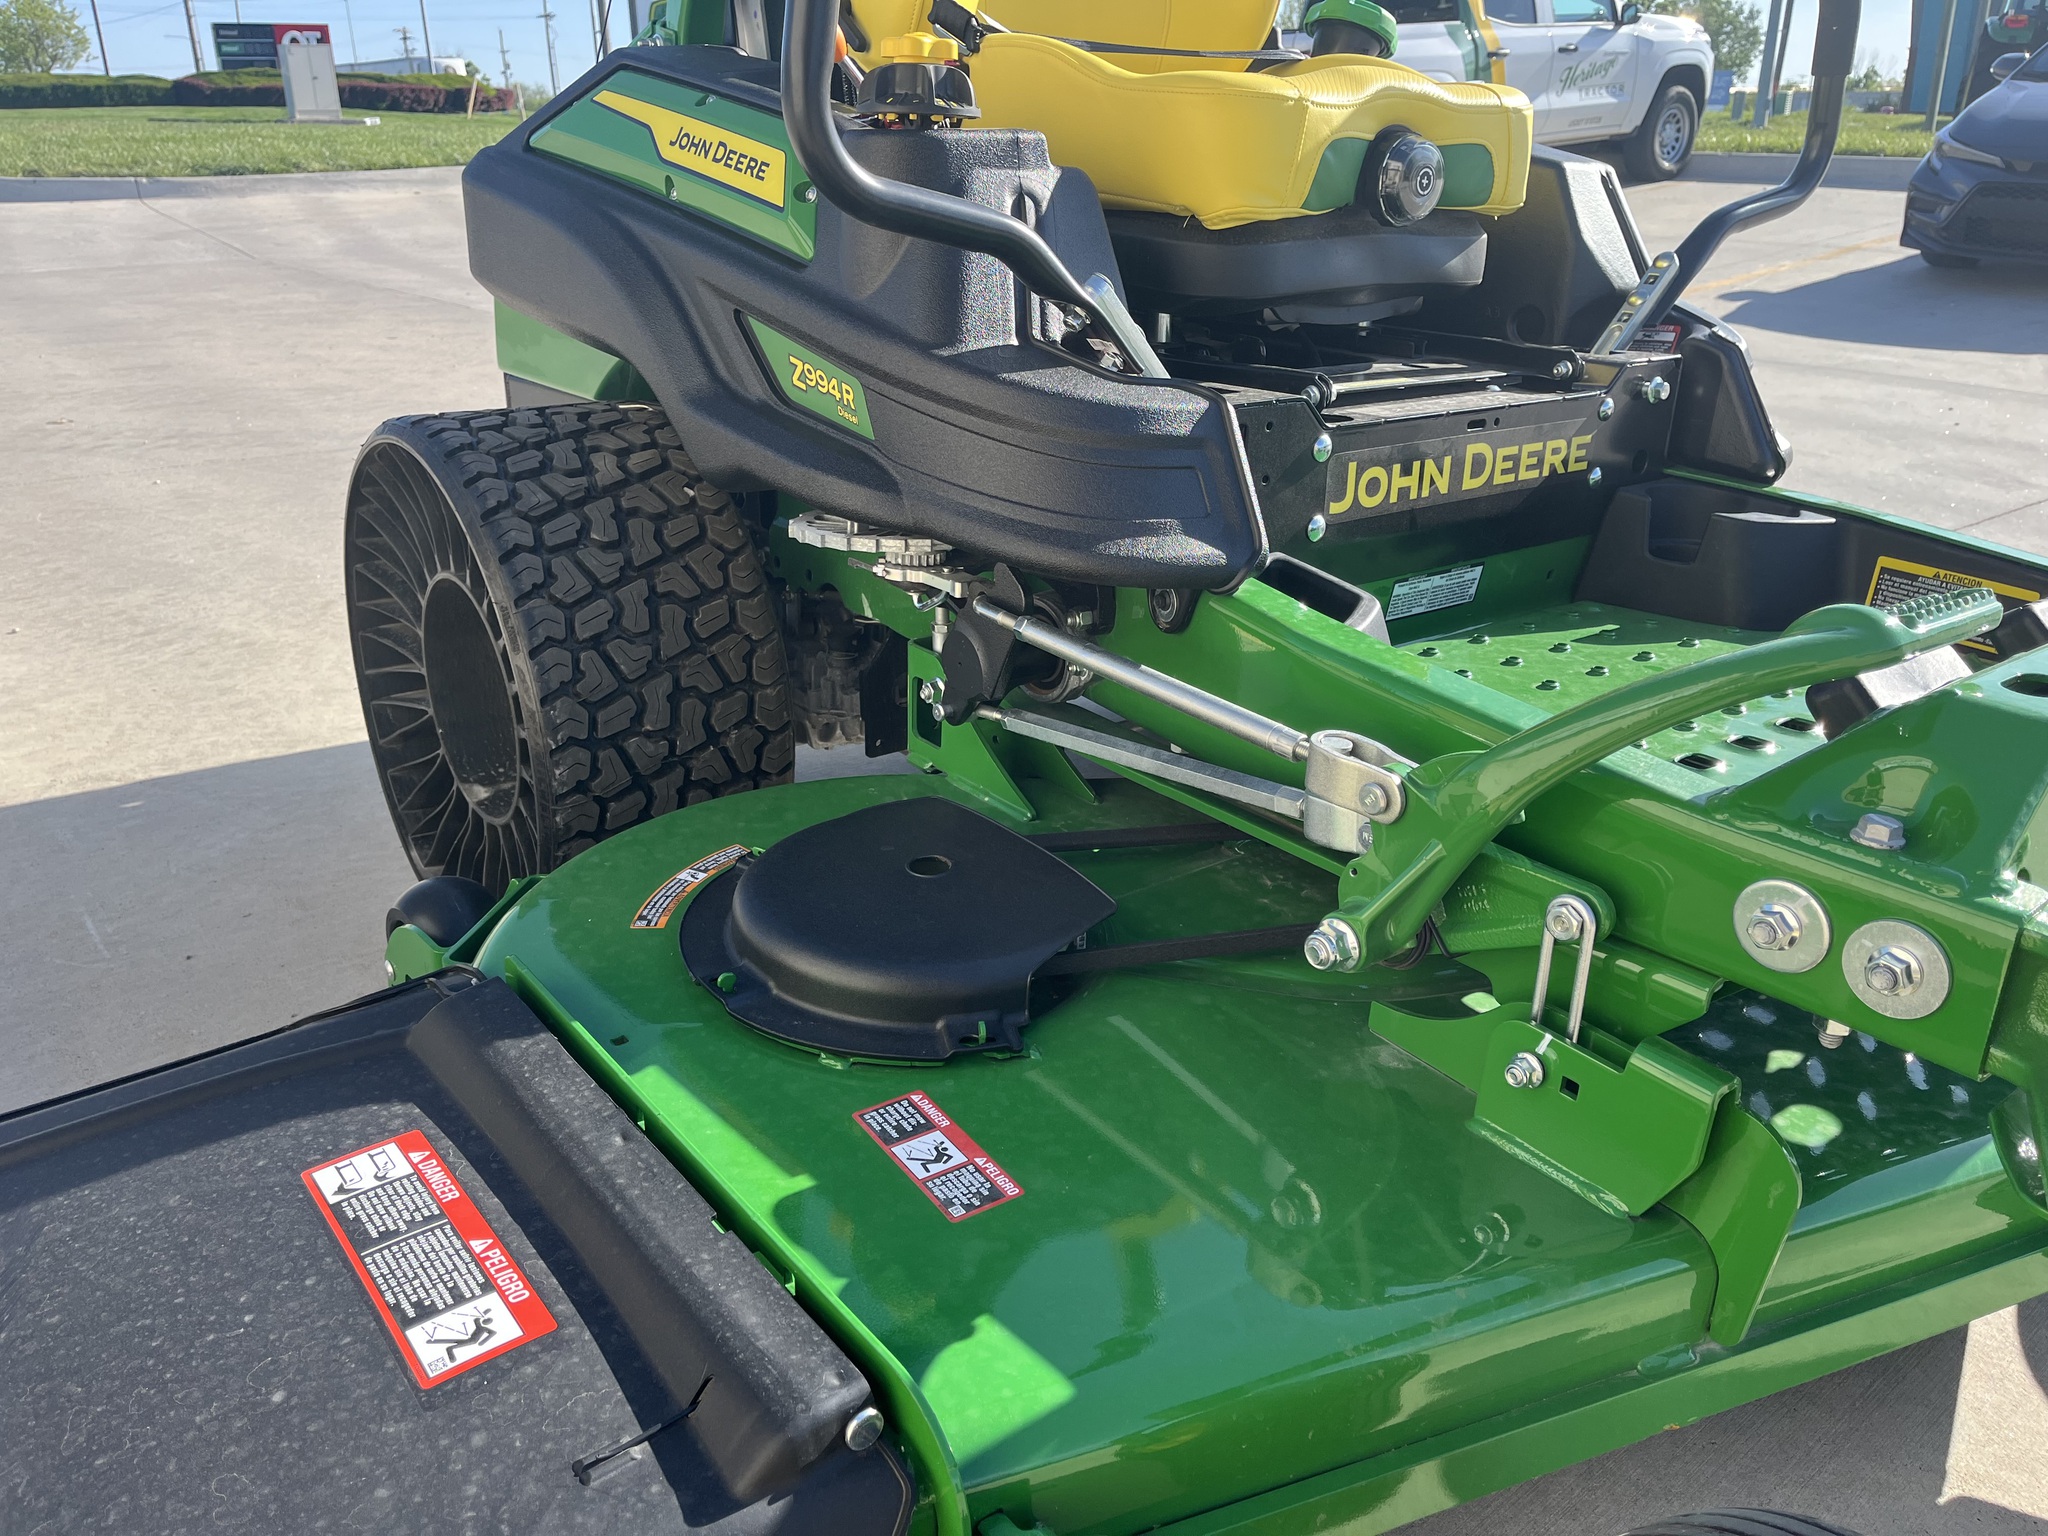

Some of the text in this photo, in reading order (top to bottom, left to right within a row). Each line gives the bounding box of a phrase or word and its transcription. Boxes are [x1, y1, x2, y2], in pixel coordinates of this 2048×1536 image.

[1556, 55, 1617, 98] Heritage
[1579, 84, 1625, 98] TRACTOR
[669, 126, 771, 182] JOHN DEERE
[788, 353, 857, 412] Z994R
[837, 405, 859, 426] Diesel
[1328, 434, 1593, 515] JOHN DEERE
[1918, 576, 1941, 587] AYUDAR
[1942, 573, 1983, 588] ATENCION
[881, 1112, 899, 1126] entire
[882, 1104, 915, 1132] charge chute
[891, 1101, 912, 1118] without
[899, 1099, 927, 1124] Do not mow
[915, 1098, 951, 1128] DANGER
[864, 1117, 884, 1133] place.
[868, 1110, 901, 1139] grass catcher
[416, 1157, 461, 1203] DANGER
[924, 1180, 936, 1188] su
[931, 1177, 944, 1186] de
[938, 1174, 950, 1182] el
[957, 1174, 973, 1187] tubo
[967, 1184, 979, 1193] de
[964, 1163, 978, 1173] No
[971, 1171, 987, 1183] usar
[979, 1161, 1021, 1196] PELIGRO
[399, 1177, 432, 1217] rotating blades and
[408, 1174, 442, 1215] To avoid injury from
[928, 1185, 949, 1202] lugar.
[937, 1183, 957, 1199] pasto
[942, 1179, 972, 1205] recogedor
[944, 1171, 971, 1195] descarga
[969, 1196, 983, 1206] sin
[977, 1186, 991, 1196] sin
[341, 1204, 358, 1221] place.
[356, 1193, 386, 1232] discharge chute or
[366, 1189, 398, 1231] Do not mow without
[374, 1186, 408, 1233] and keep others away.
[383, 1183, 414, 1222] clear of deck edge
[391, 1180, 425, 1223] thrown objects, stay
[950, 1197, 962, 1206] en
[348, 1196, 381, 1239] entire grass catcher
[400, 1244, 412, 1254] los
[405, 1237, 428, 1262] plataforma
[405, 1251, 422, 1269] demás
[414, 1233, 456, 1288] alejado del borde de la
[441, 1223, 487, 1284] Para evitar sufrir lesiones
[370, 1251, 392, 1275] descarga
[421, 1259, 432, 1268] de
[425, 1233, 443, 1252] objetos
[435, 1249, 457, 1273] lanzados,
[449, 1269, 474, 1299] mantenerse
[425, 1265, 440, 1280] corte
[432, 1227, 484, 1297] causados por cuchillas giratorias
[362, 1255, 399, 1308] de pasto en su lugar.
[379, 1247, 420, 1303] máquina sin el tubo de
[387, 1276, 399, 1287] sin
[389, 1244, 434, 1306] de la máquina. No usar la
[413, 1266, 433, 1290] personas
[478, 1246, 532, 1305] PELIGRO
[391, 1284, 403, 1294] el
[426, 1286, 447, 1310] alejadas
[435, 1281, 456, 1305] mantener
[393, 1290, 418, 1320] recogedor
